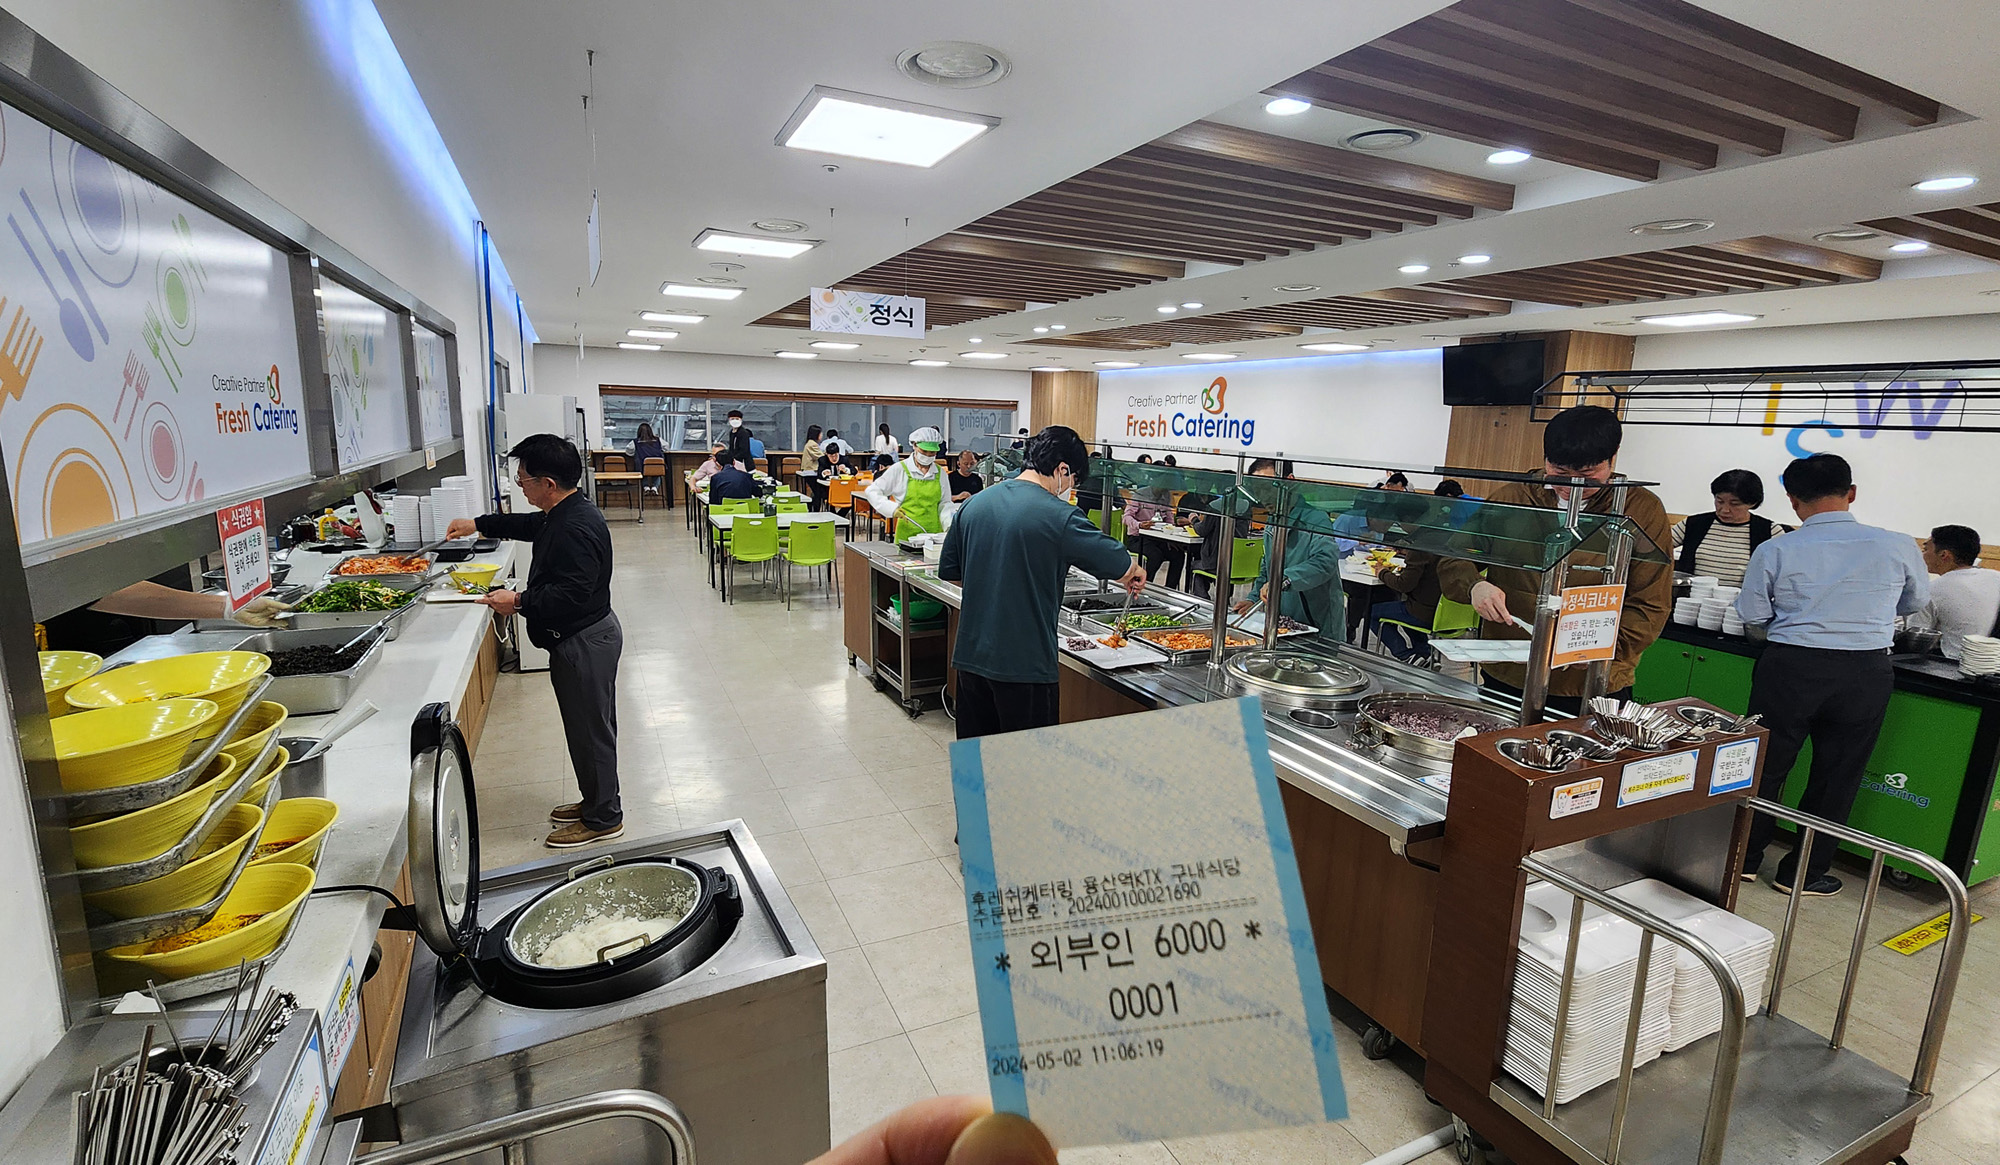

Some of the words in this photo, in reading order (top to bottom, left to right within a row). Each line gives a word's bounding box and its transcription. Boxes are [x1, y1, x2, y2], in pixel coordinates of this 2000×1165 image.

[869, 303, 914, 328] 정식
[212, 374, 243, 391] Creative
[243, 377, 265, 393] Partner
[1128, 395, 1162, 408] Creative
[1165, 393, 1197, 407] Partner
[215, 402, 251, 433] Fresh
[253, 402, 298, 434] Catering
[1126, 413, 1167, 437] Fresh
[1172, 412, 1255, 446] Catering
[231, 505, 253, 530] 식권함
[1567, 592, 1609, 611] 정식코너
[1571, 629, 1597, 641] 있습니다!
[1860, 776, 1930, 808] Catering
[971, 879, 1073, 905] 후레쉬케터링
[1082, 868, 1162, 893] 용산역KTX
[1171, 857, 1241, 882] 구내식당
[972, 904, 1042, 928] 주문번호
[1068, 881, 1201, 915] 202400100021690
[1030, 927, 1135, 973] 외부인
[1154, 918, 1227, 958] 6000
[1109, 980, 1180, 1021] 0001
[991, 1048, 1083, 1076] 2024-05-02
[1092, 1037, 1165, 1065] 11:06:19
